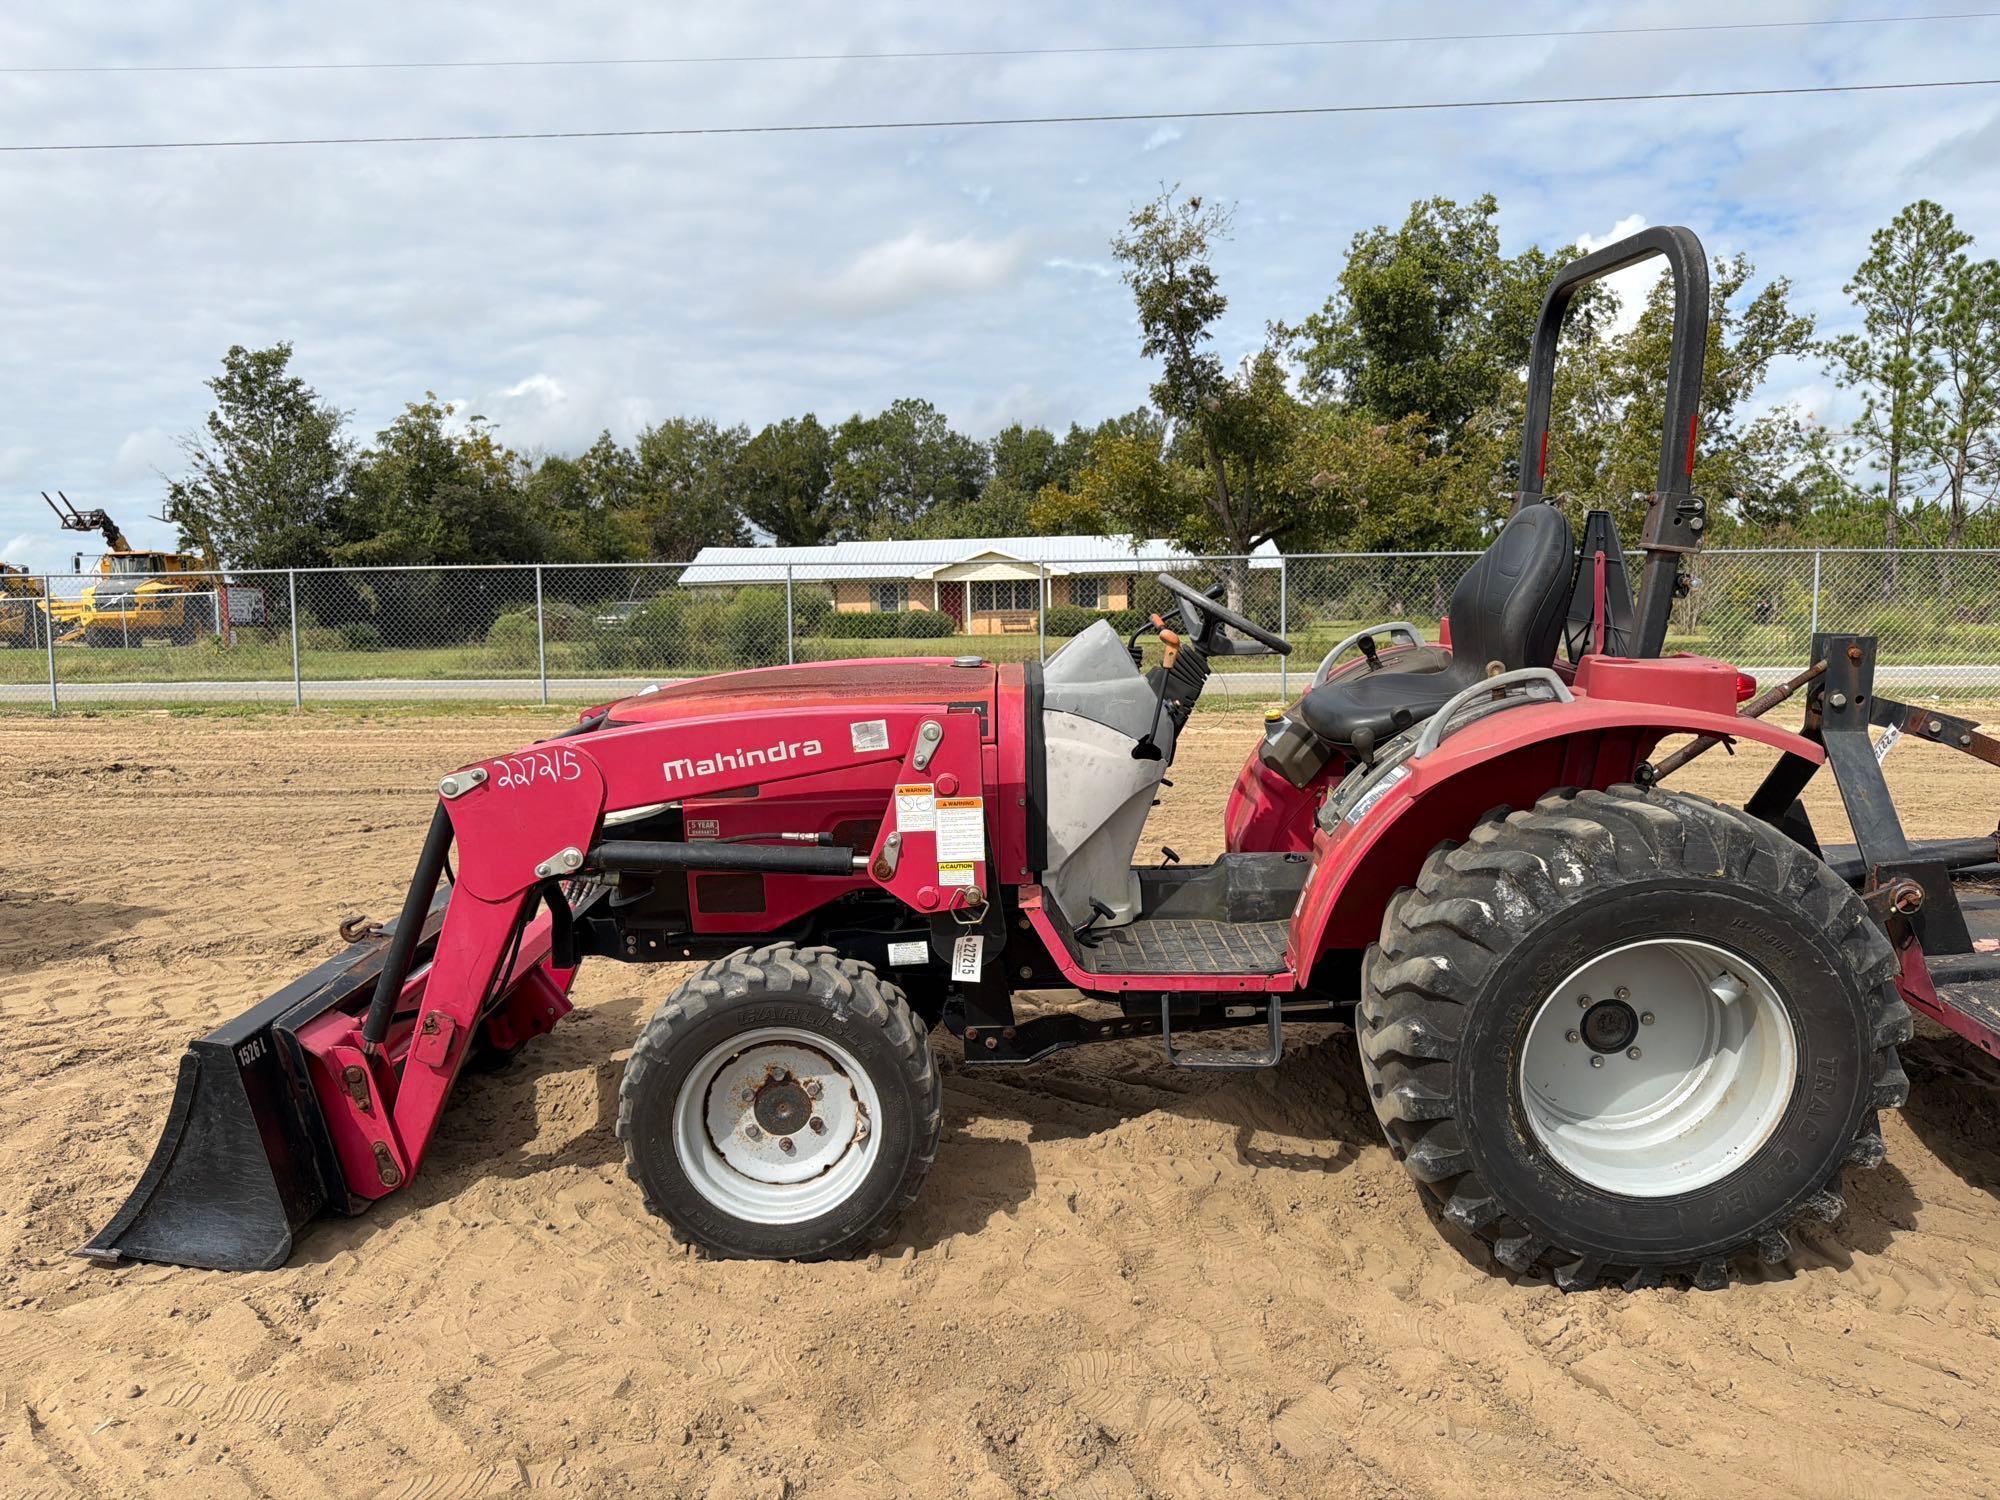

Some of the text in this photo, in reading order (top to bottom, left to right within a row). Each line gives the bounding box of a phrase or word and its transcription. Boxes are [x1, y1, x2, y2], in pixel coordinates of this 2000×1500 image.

[493, 750, 582, 790] 227215
[663, 737, 823, 782] Mahindra
[905, 786, 932, 794] WARNING
[691, 821, 715, 829] 5 YEAR
[961, 943, 977, 975] 227215
[238, 1040, 261, 1067] 1526
[1798, 1055, 1840, 1143] TRAC
